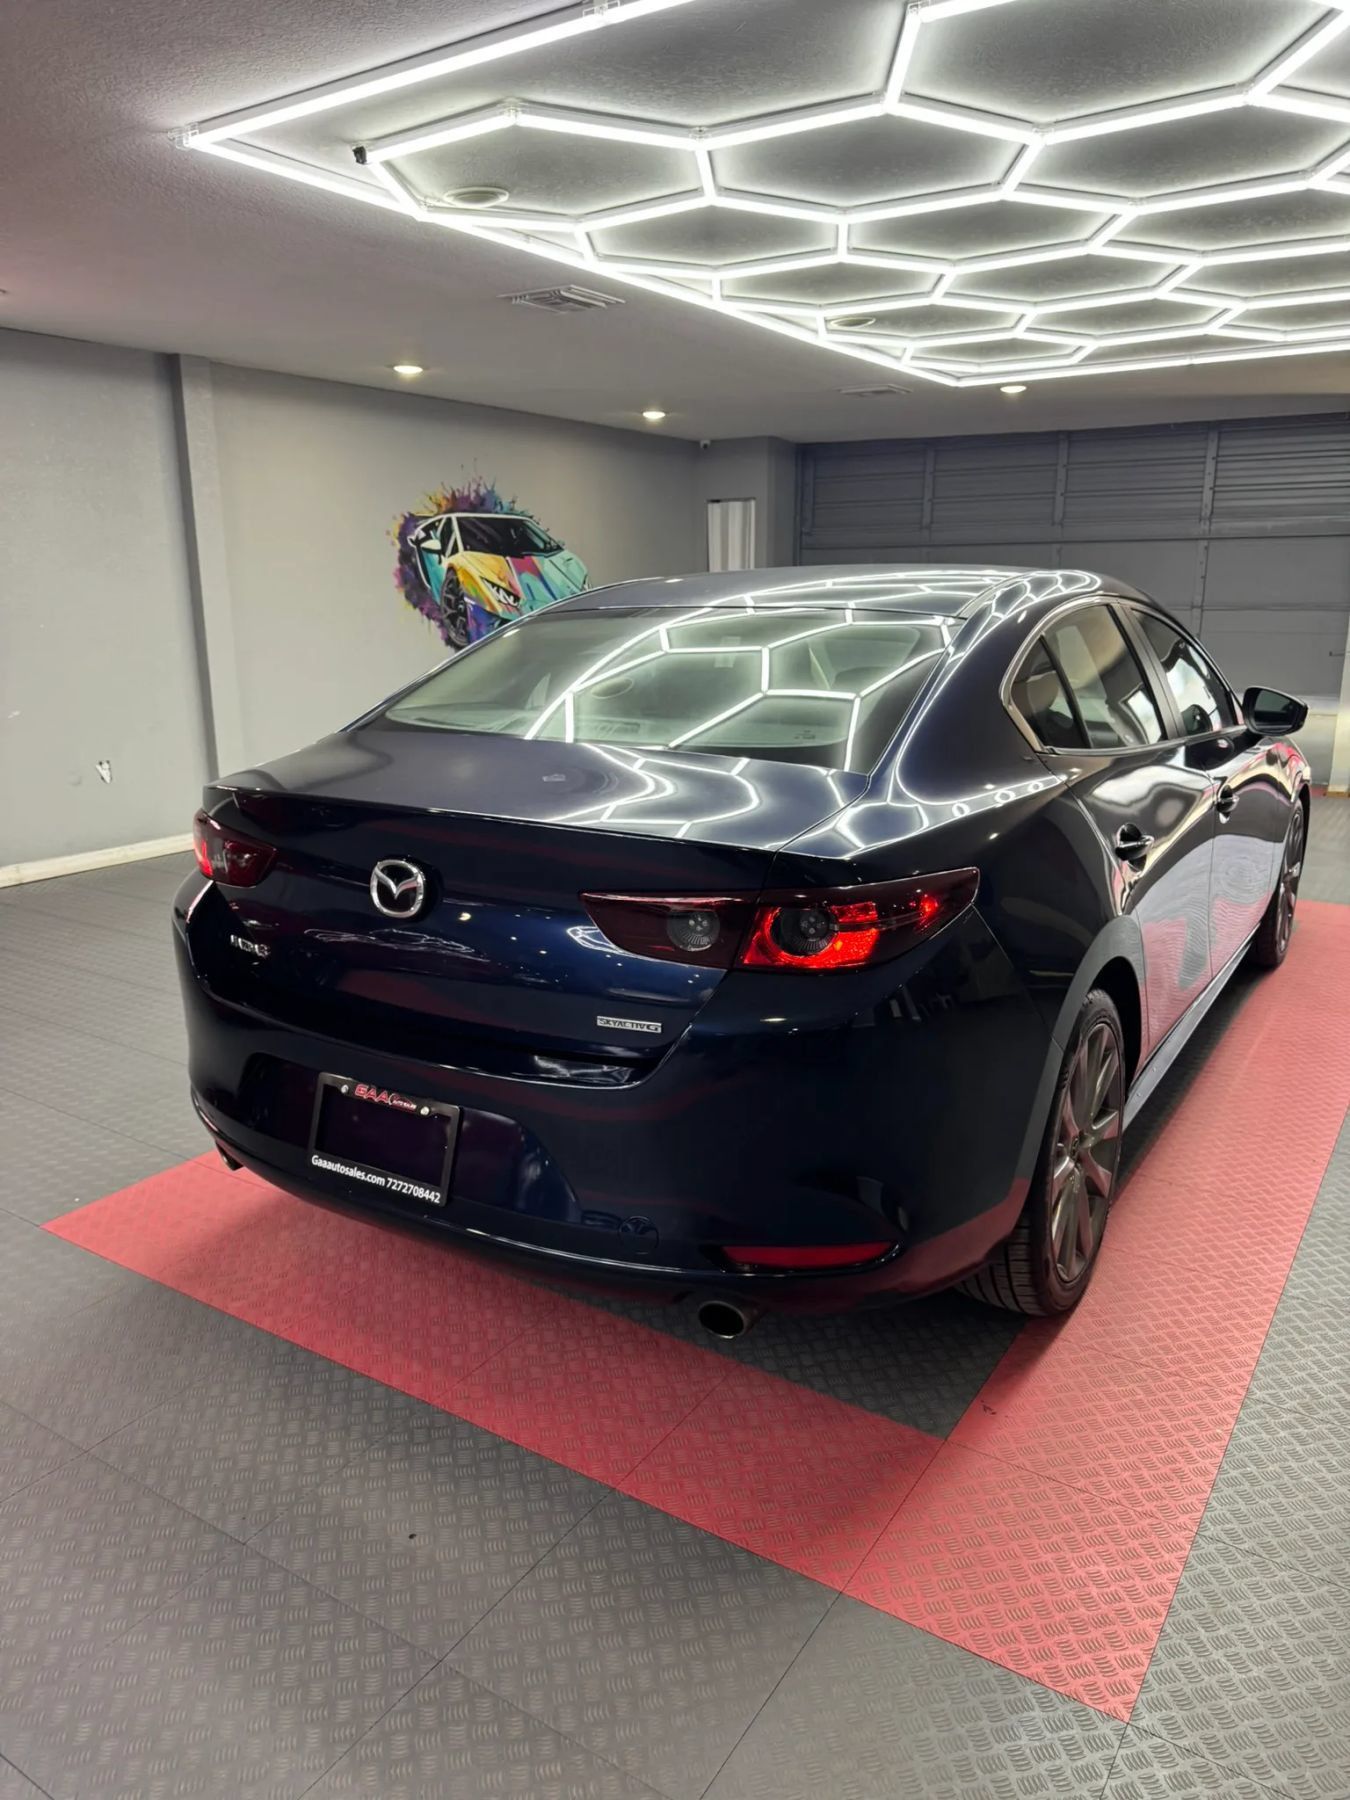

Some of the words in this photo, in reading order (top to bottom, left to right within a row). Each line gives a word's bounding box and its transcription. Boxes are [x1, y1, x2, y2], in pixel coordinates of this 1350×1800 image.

[355, 1083, 389, 1103] GAA
[311, 1155, 385, 1187] Gaaautosales.com
[386, 1177, 441, 1204] 7272708442
